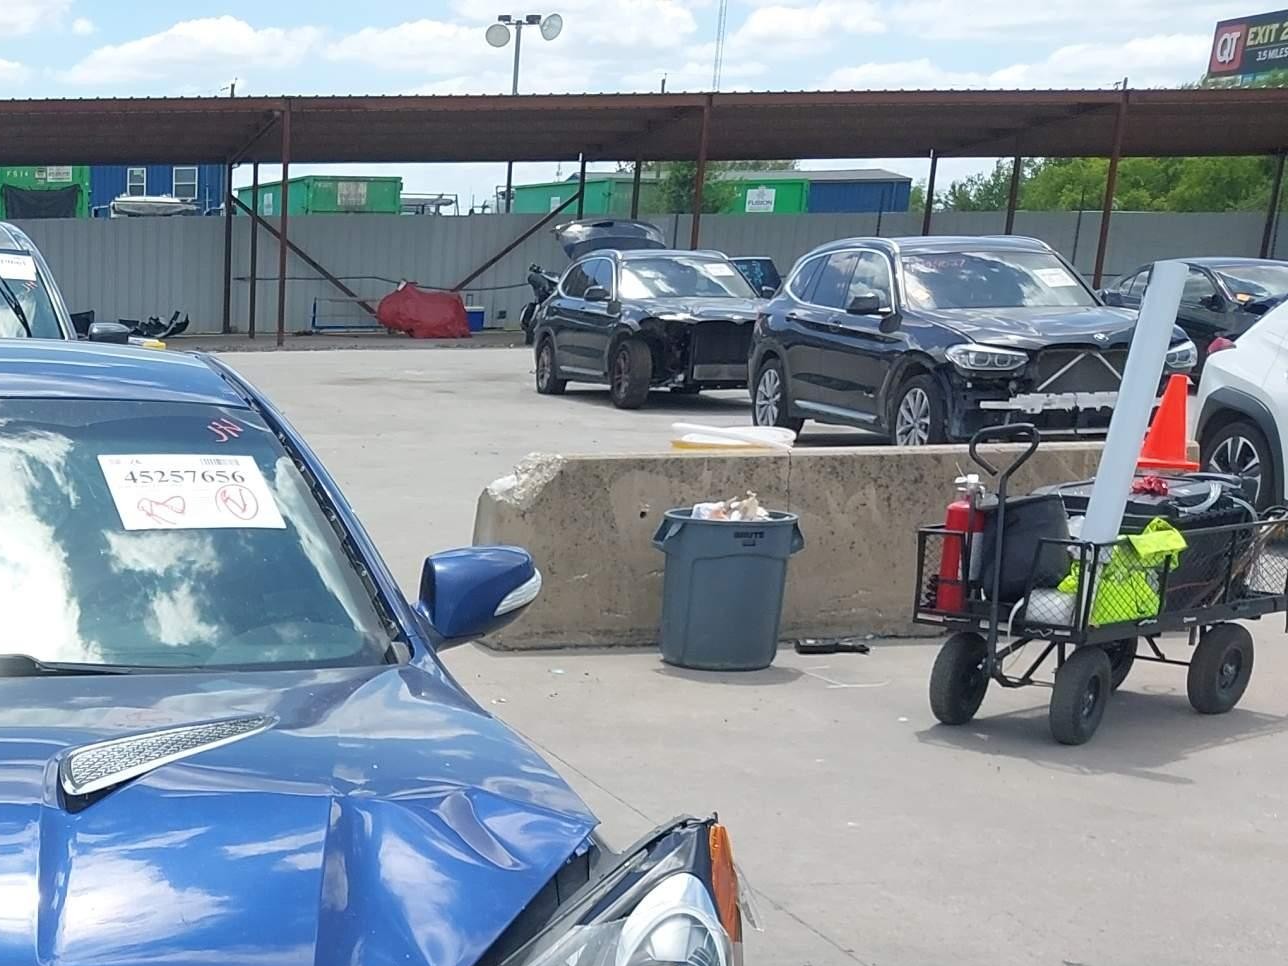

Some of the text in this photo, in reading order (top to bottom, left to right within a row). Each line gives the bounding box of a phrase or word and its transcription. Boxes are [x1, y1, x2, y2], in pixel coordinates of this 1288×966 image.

[1246, 23, 1279, 47] EXIT
[1216, 31, 1241, 65] QT
[123, 469, 246, 485] 45257656
